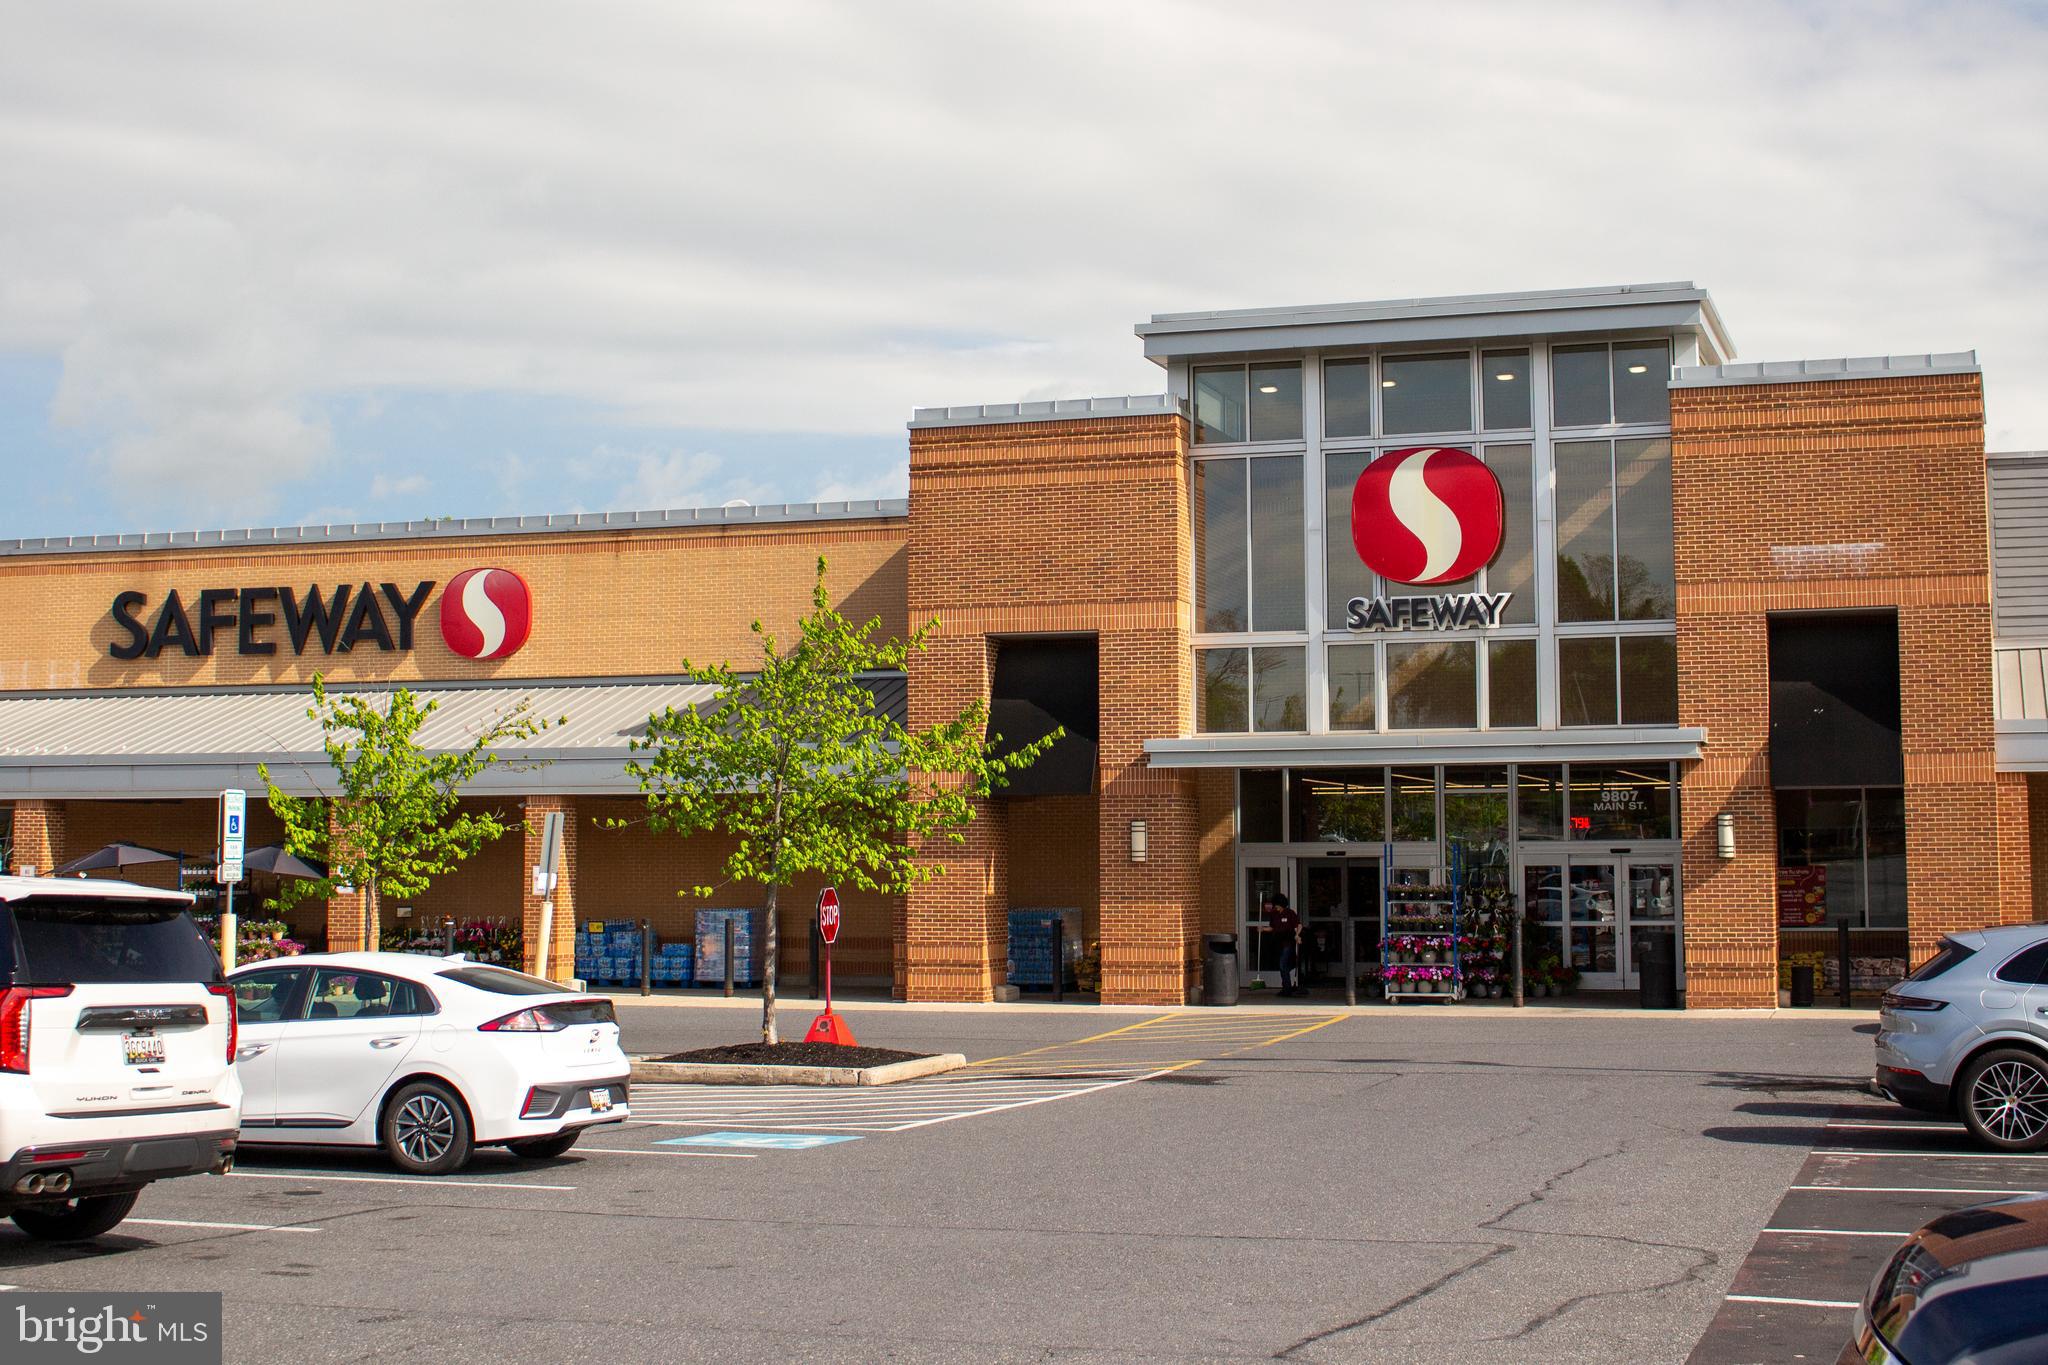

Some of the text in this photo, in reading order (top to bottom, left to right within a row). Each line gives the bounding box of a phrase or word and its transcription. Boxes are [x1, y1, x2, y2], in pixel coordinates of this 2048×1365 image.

[110, 580, 437, 660] SAFEWAY
[1347, 592, 1511, 633] SAFEWAY
[1593, 801, 1648, 811] MAIN ST.
[1601, 790, 1638, 802] 9807
[822, 905, 838, 926] STOP
